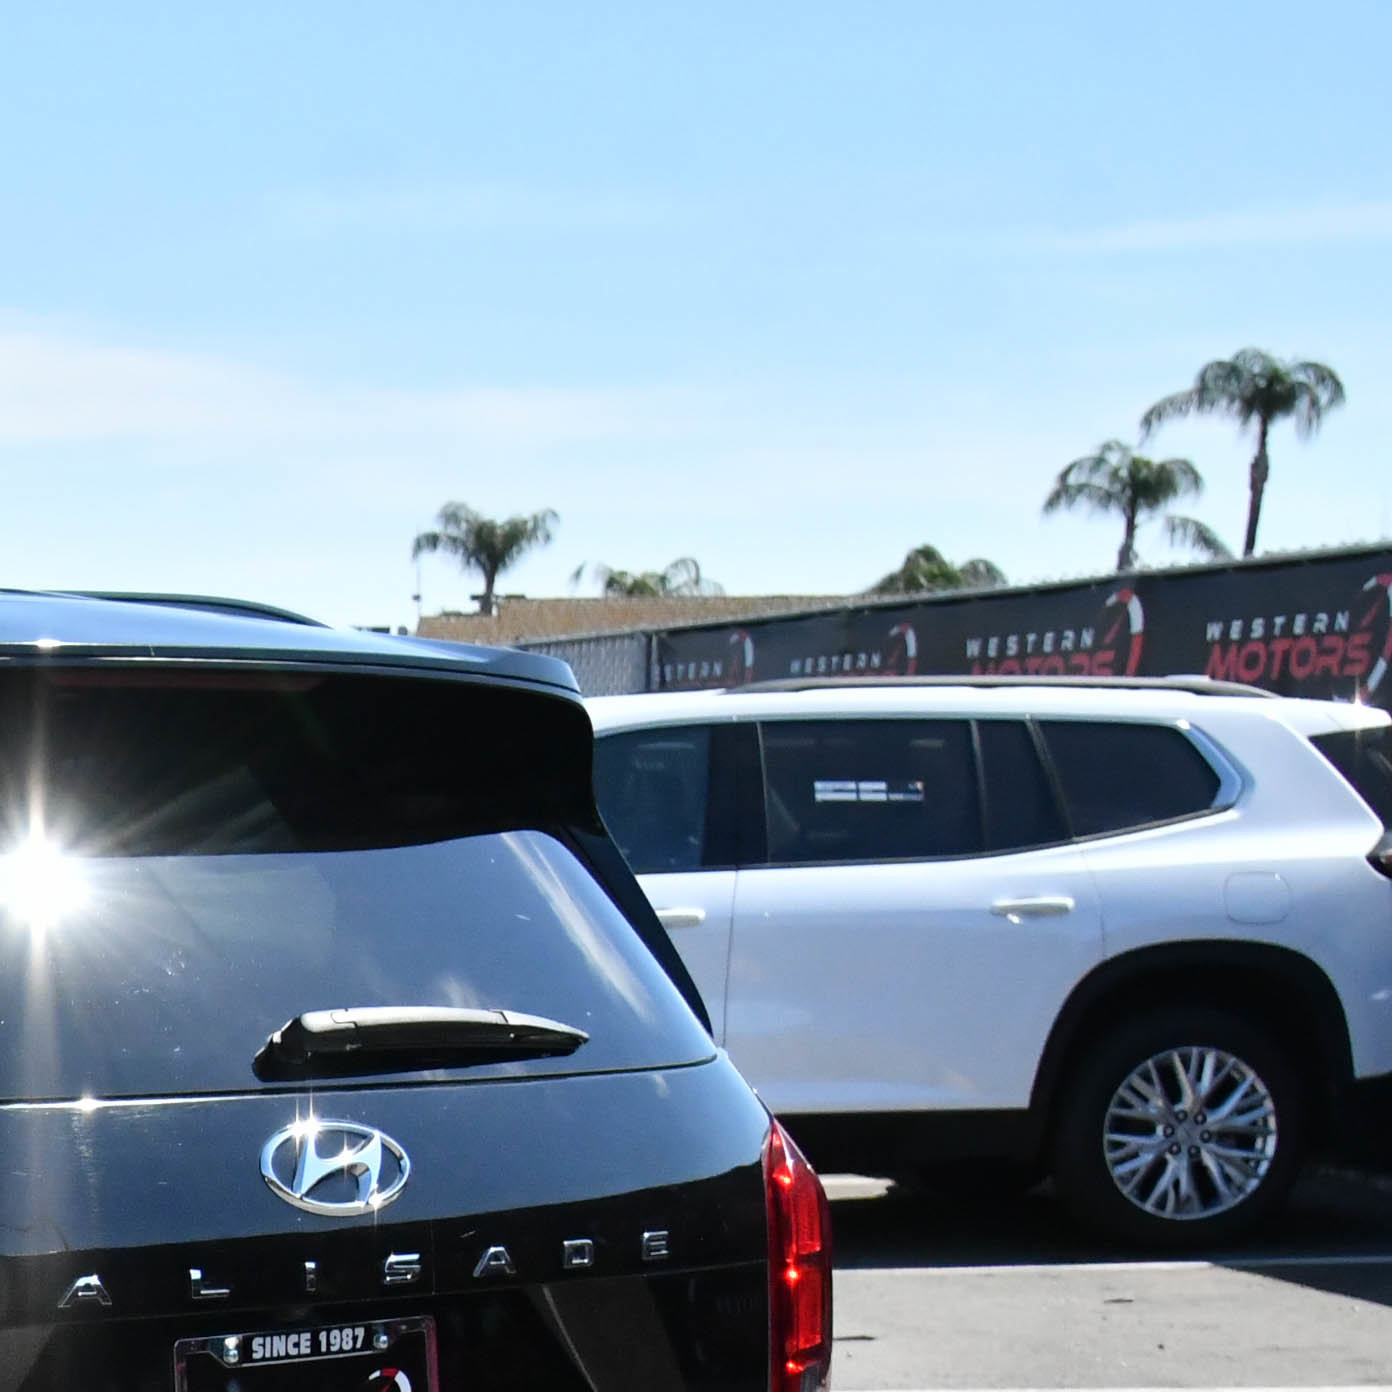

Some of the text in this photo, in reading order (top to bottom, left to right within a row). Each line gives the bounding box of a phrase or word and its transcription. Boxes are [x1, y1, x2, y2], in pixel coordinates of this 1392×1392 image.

[1205, 611, 1350, 641] WESTERN
[966, 627, 1095, 659] WESTERN
[1206, 632, 1373, 682] MOTORS
[252, 1327, 365, 1360] SINCE 1987
